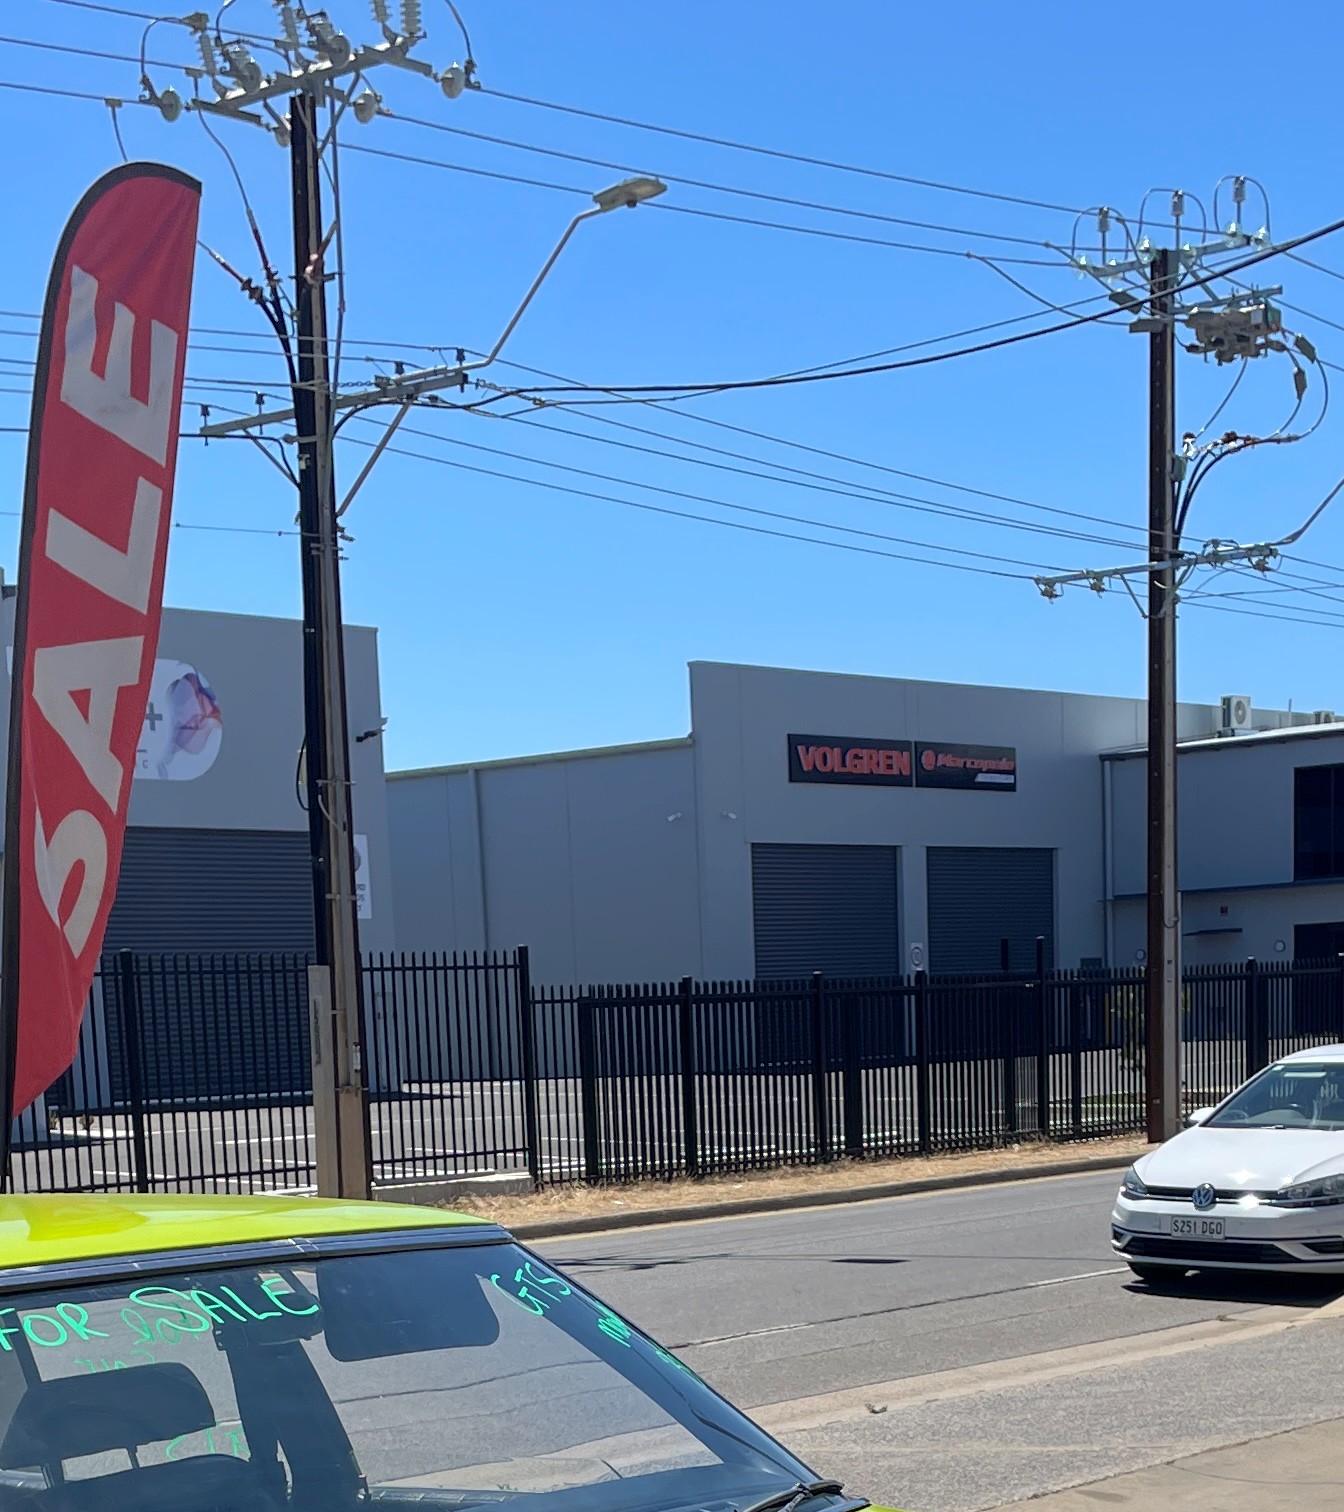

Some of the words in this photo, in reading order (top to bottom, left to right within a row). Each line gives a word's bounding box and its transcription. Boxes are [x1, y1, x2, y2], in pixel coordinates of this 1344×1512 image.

[33, 264, 177, 960] SALE
[797, 744, 911, 776] VOLGREN
[1172, 1219, 1197, 1234] S251
[129, 1277, 319, 1333] SALE
[490, 1262, 572, 1316] GTS
